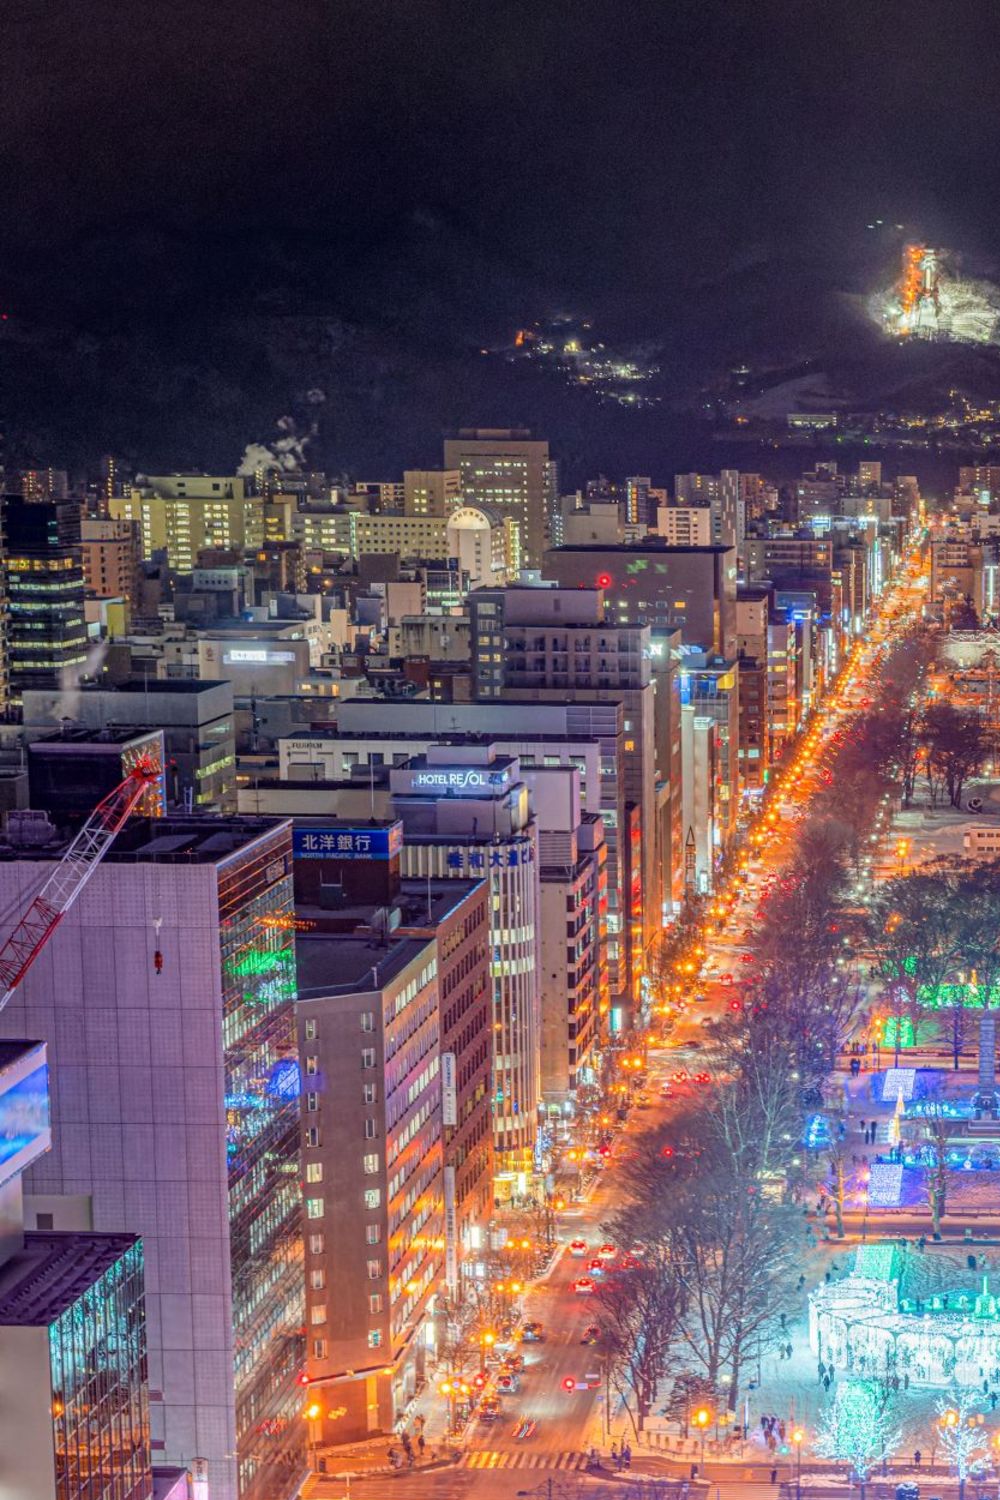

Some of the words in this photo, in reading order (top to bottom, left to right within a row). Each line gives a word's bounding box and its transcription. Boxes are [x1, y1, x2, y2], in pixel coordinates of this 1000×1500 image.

[419, 775, 448, 785] HOTEL
[302, 834, 371, 851] 北洋銀行
